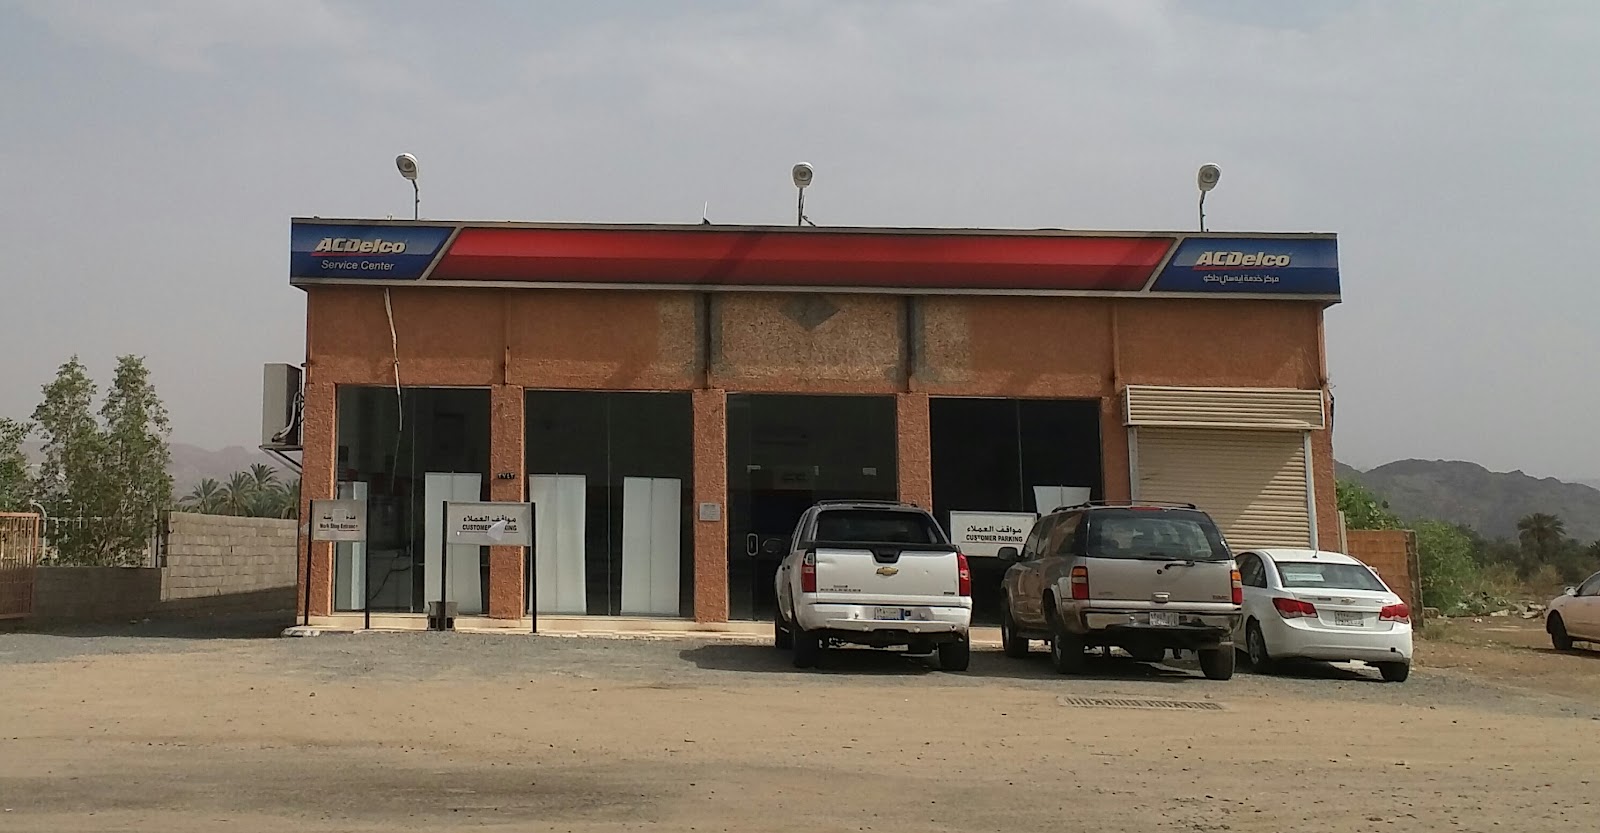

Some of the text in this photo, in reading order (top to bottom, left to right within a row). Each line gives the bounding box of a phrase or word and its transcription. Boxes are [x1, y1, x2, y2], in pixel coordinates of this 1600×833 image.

[314, 237, 407, 254] ACDelco
[1195, 251, 1291, 267] ACDelco
[321, 259, 395, 271] Service Center
[1244, 274, 1263, 282] خدمة
[1263, 274, 1280, 284] مركز
[463, 514, 517, 524] مواقف العملاء
[966, 525, 1022, 535] مواقف العملاء
[965, 534, 997, 542] CUSTOMER
